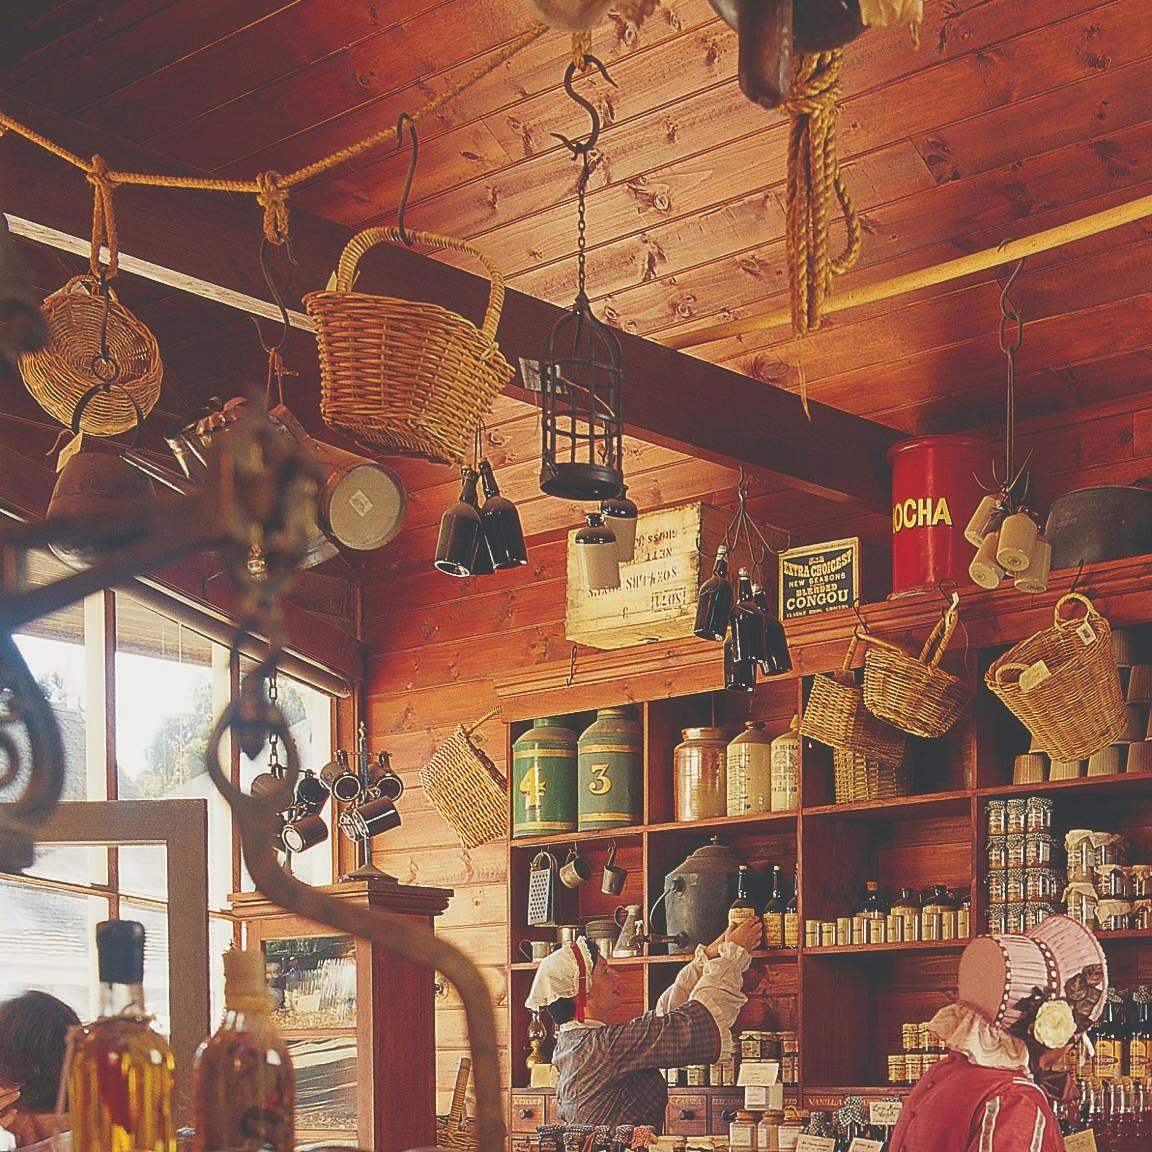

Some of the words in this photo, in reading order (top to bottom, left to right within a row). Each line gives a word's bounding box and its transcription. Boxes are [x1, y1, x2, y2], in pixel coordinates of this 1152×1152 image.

[893, 497, 952, 534] OCHA
[784, 560, 810, 578] EXTRA
[810, 549, 852, 577] CHOICEST
[788, 580, 805, 588] NEW
[809, 572, 846, 585] SEASONS
[786, 589, 849, 610] CONGOU
[520, 766, 546, 808] 4
[589, 763, 612, 795] 3
[808, 1098, 842, 1106] VANILLA
